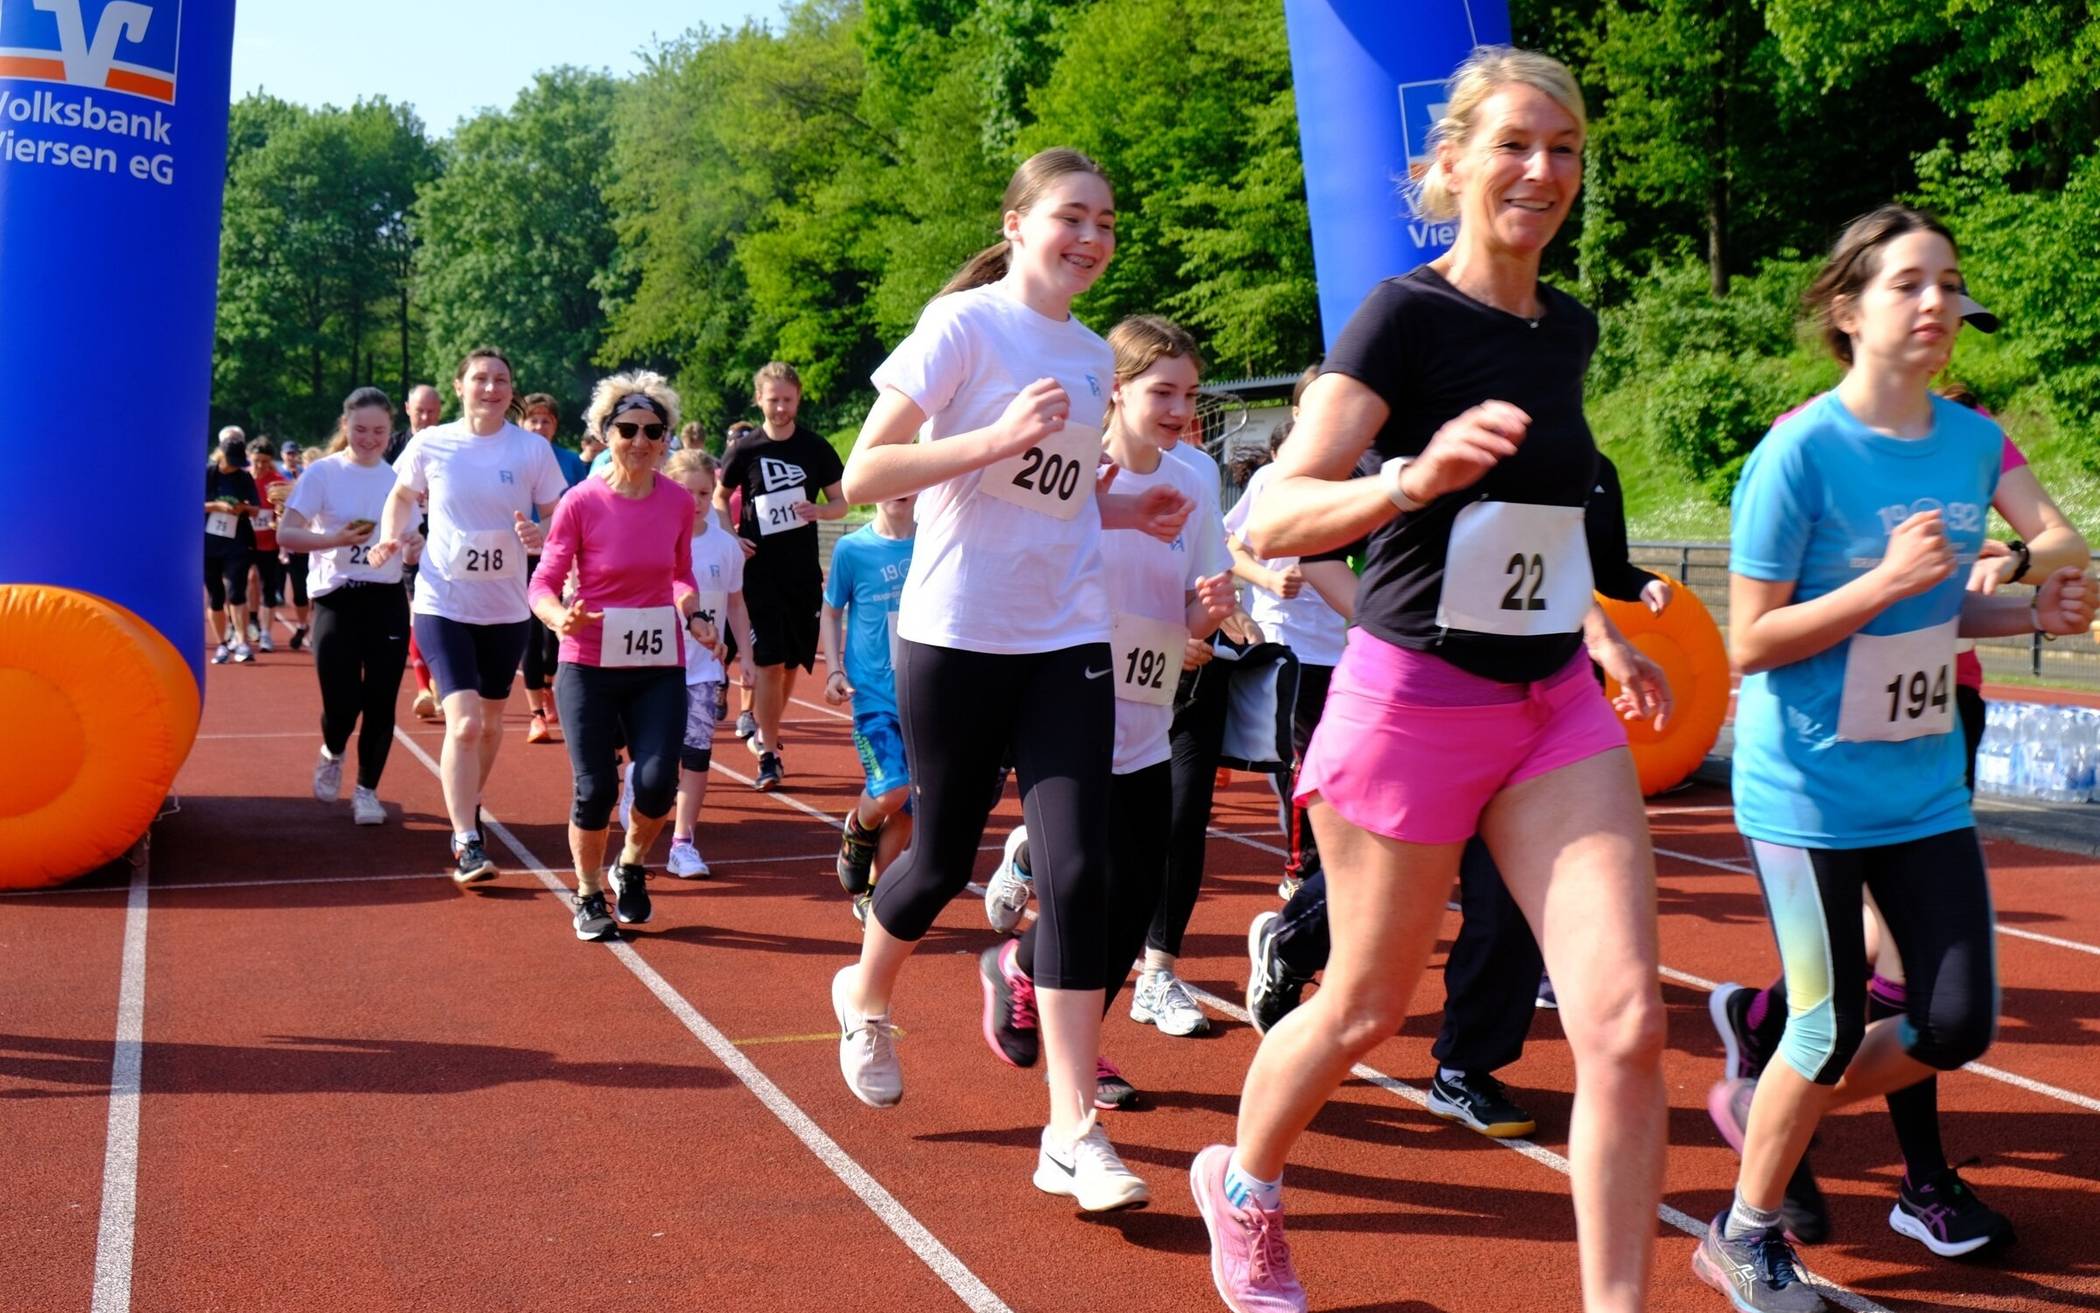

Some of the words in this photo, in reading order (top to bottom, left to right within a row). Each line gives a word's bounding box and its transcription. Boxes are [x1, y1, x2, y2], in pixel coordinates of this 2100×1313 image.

[129, 154, 173, 185] eG
[1407, 222, 1458, 249] Vie
[1012, 447, 1080, 501] 200
[350, 545, 371, 565] 22
[466, 548, 503, 571] 218
[1500, 553, 1547, 610] 22
[623, 629, 663, 655] 145
[1124, 647, 1166, 688] 192
[1885, 664, 1951, 722] 194
